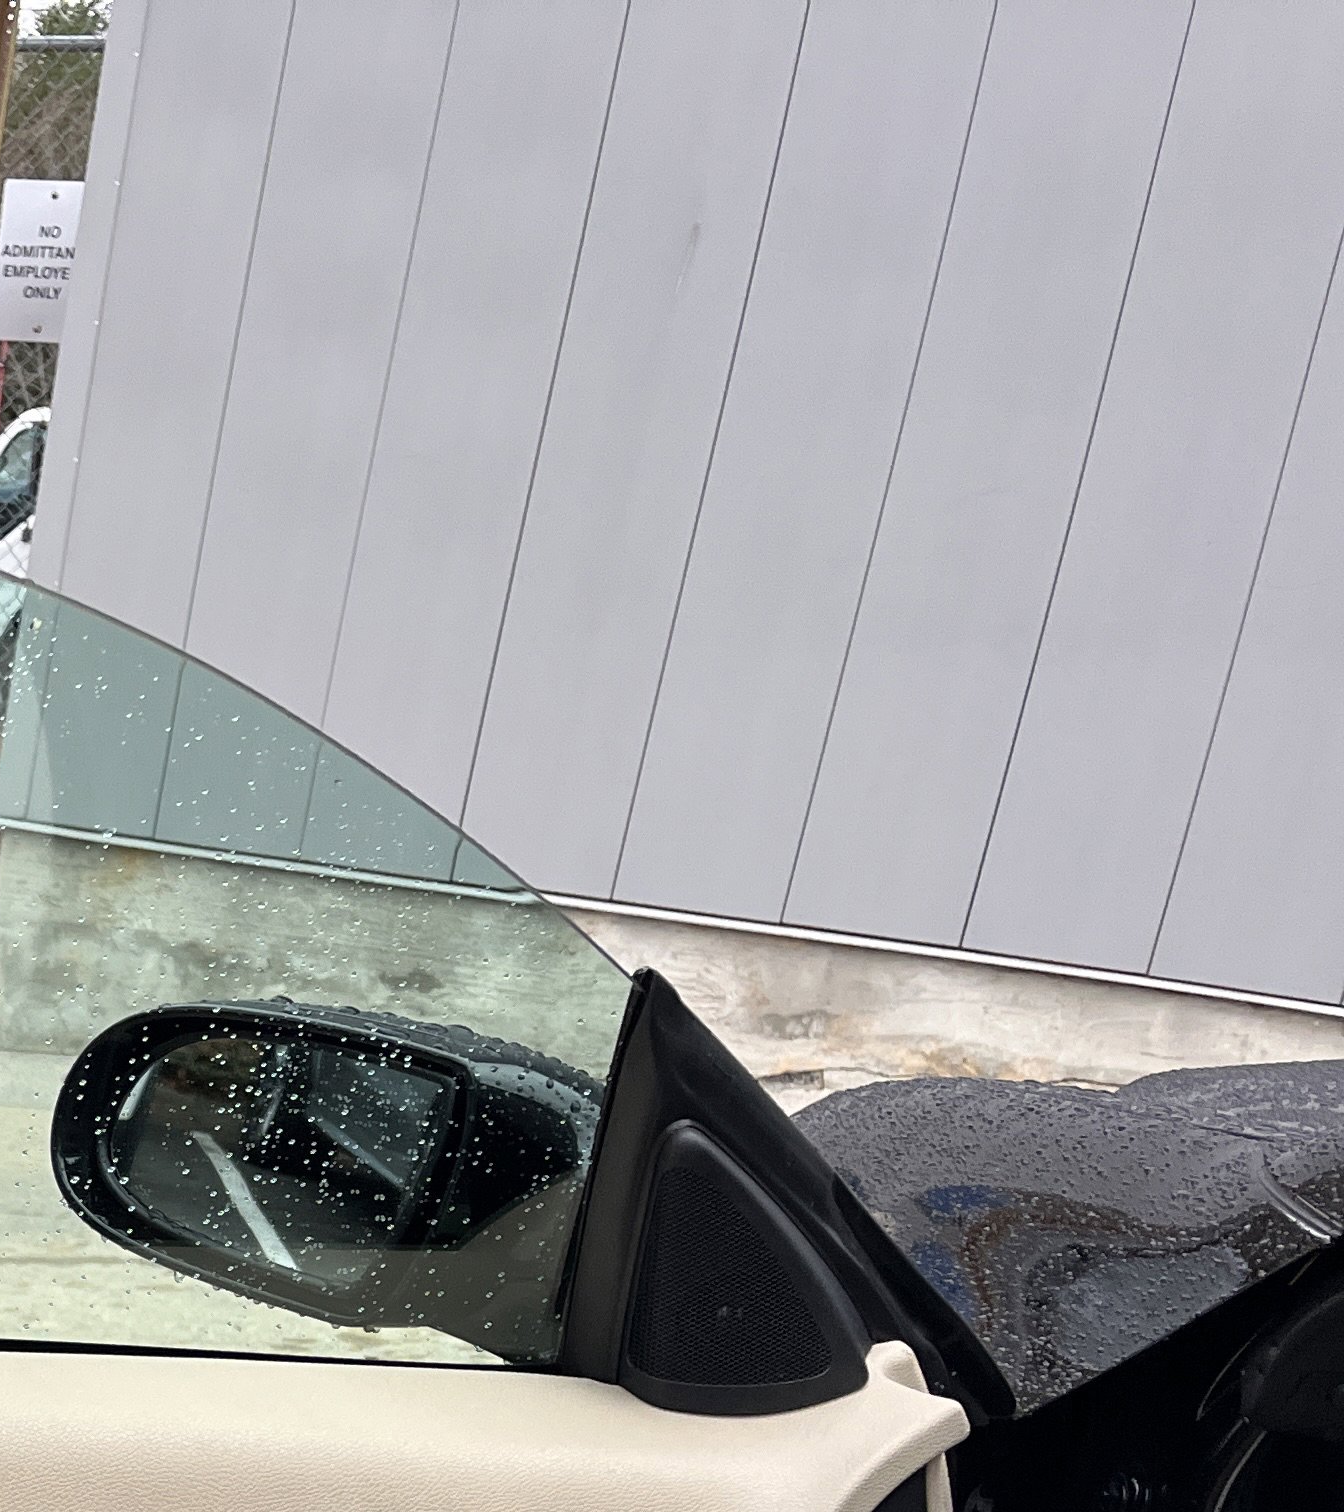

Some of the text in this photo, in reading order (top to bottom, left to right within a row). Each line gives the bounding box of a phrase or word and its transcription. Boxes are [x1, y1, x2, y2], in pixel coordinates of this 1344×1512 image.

[38, 225, 62, 239] NO
[1, 244, 76, 260] ADMITTAN
[2, 264, 72, 281] EMPLOYE
[22, 285, 62, 300] ONLY
